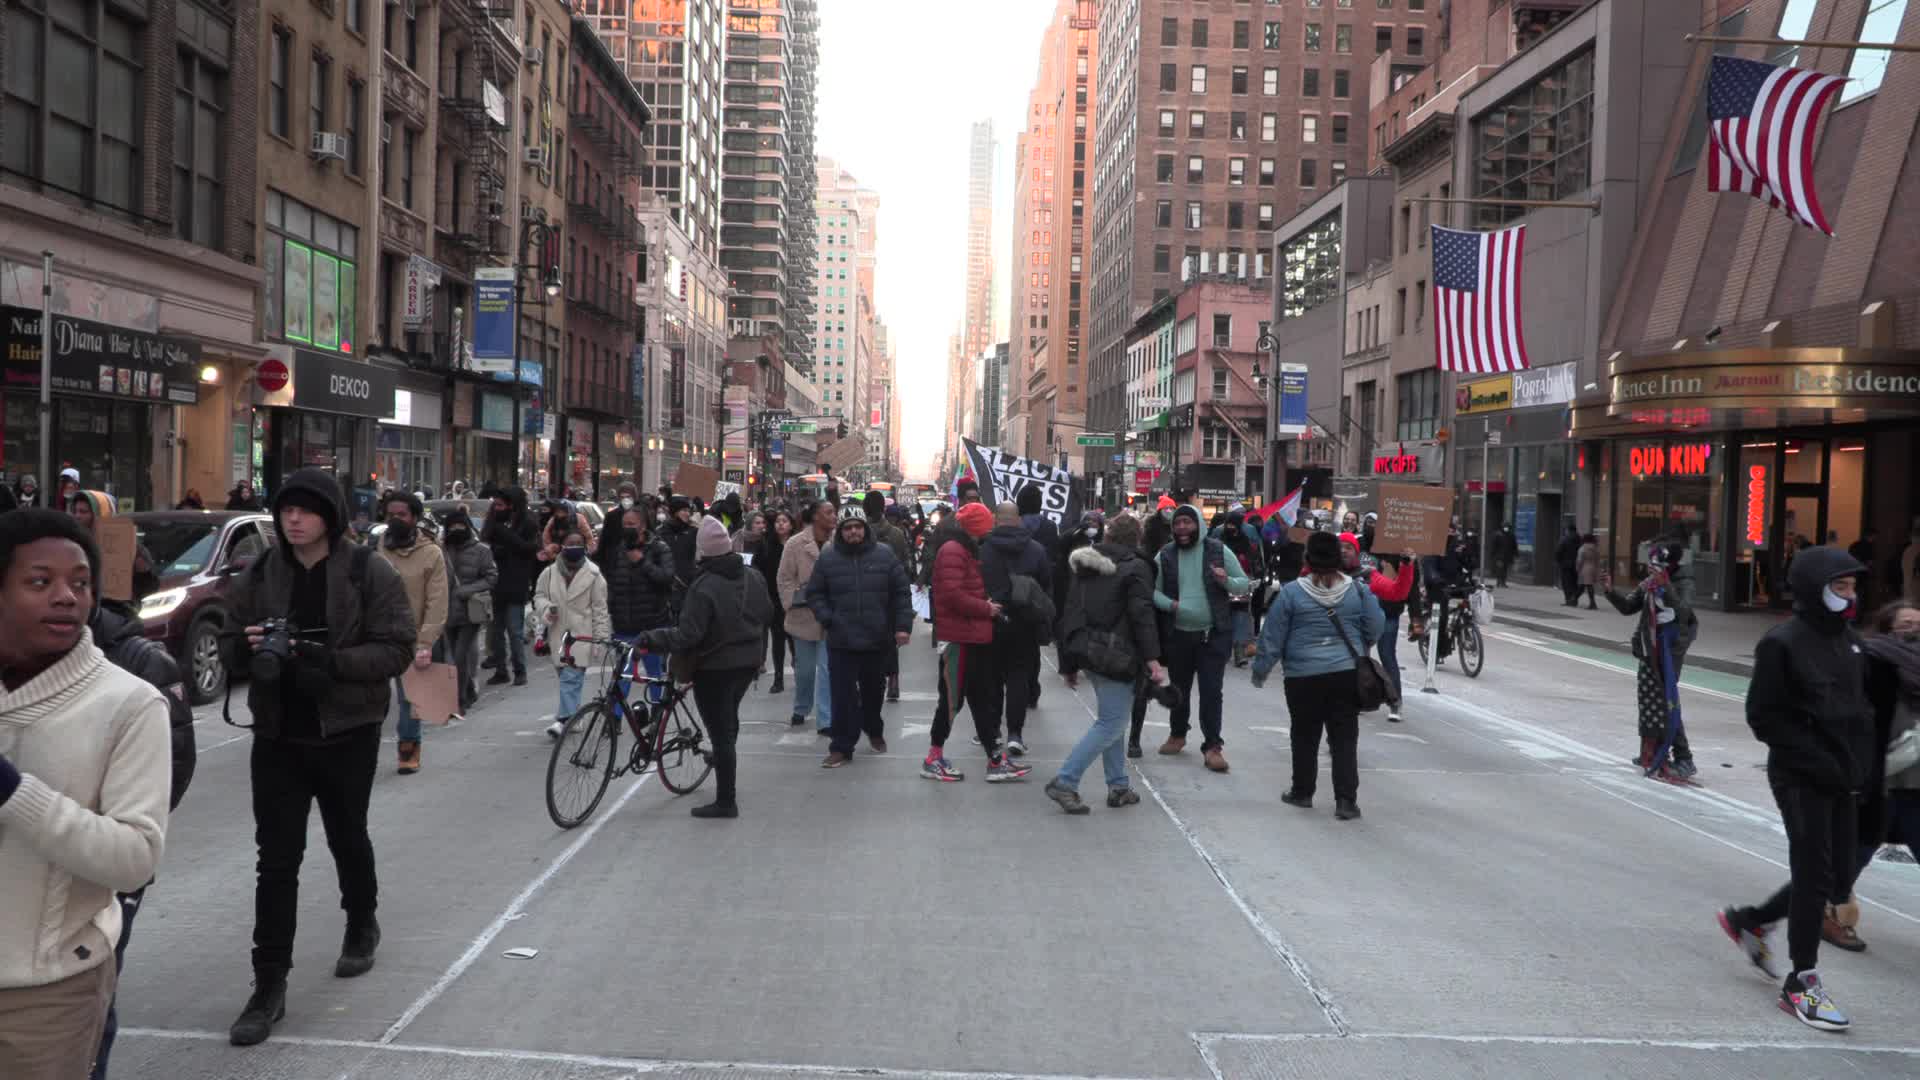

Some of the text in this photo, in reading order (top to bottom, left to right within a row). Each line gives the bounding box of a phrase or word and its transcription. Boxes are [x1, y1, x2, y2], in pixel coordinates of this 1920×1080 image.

[408, 272, 417, 315] BARBER
[55, 320, 103, 355] Diana
[330, 374, 370, 399] DEKCO
[1661, 374, 1701, 395] Inn
[1794, 368, 1920, 393] Residenc
[1374, 447, 1418, 474] NYC GIFTS
